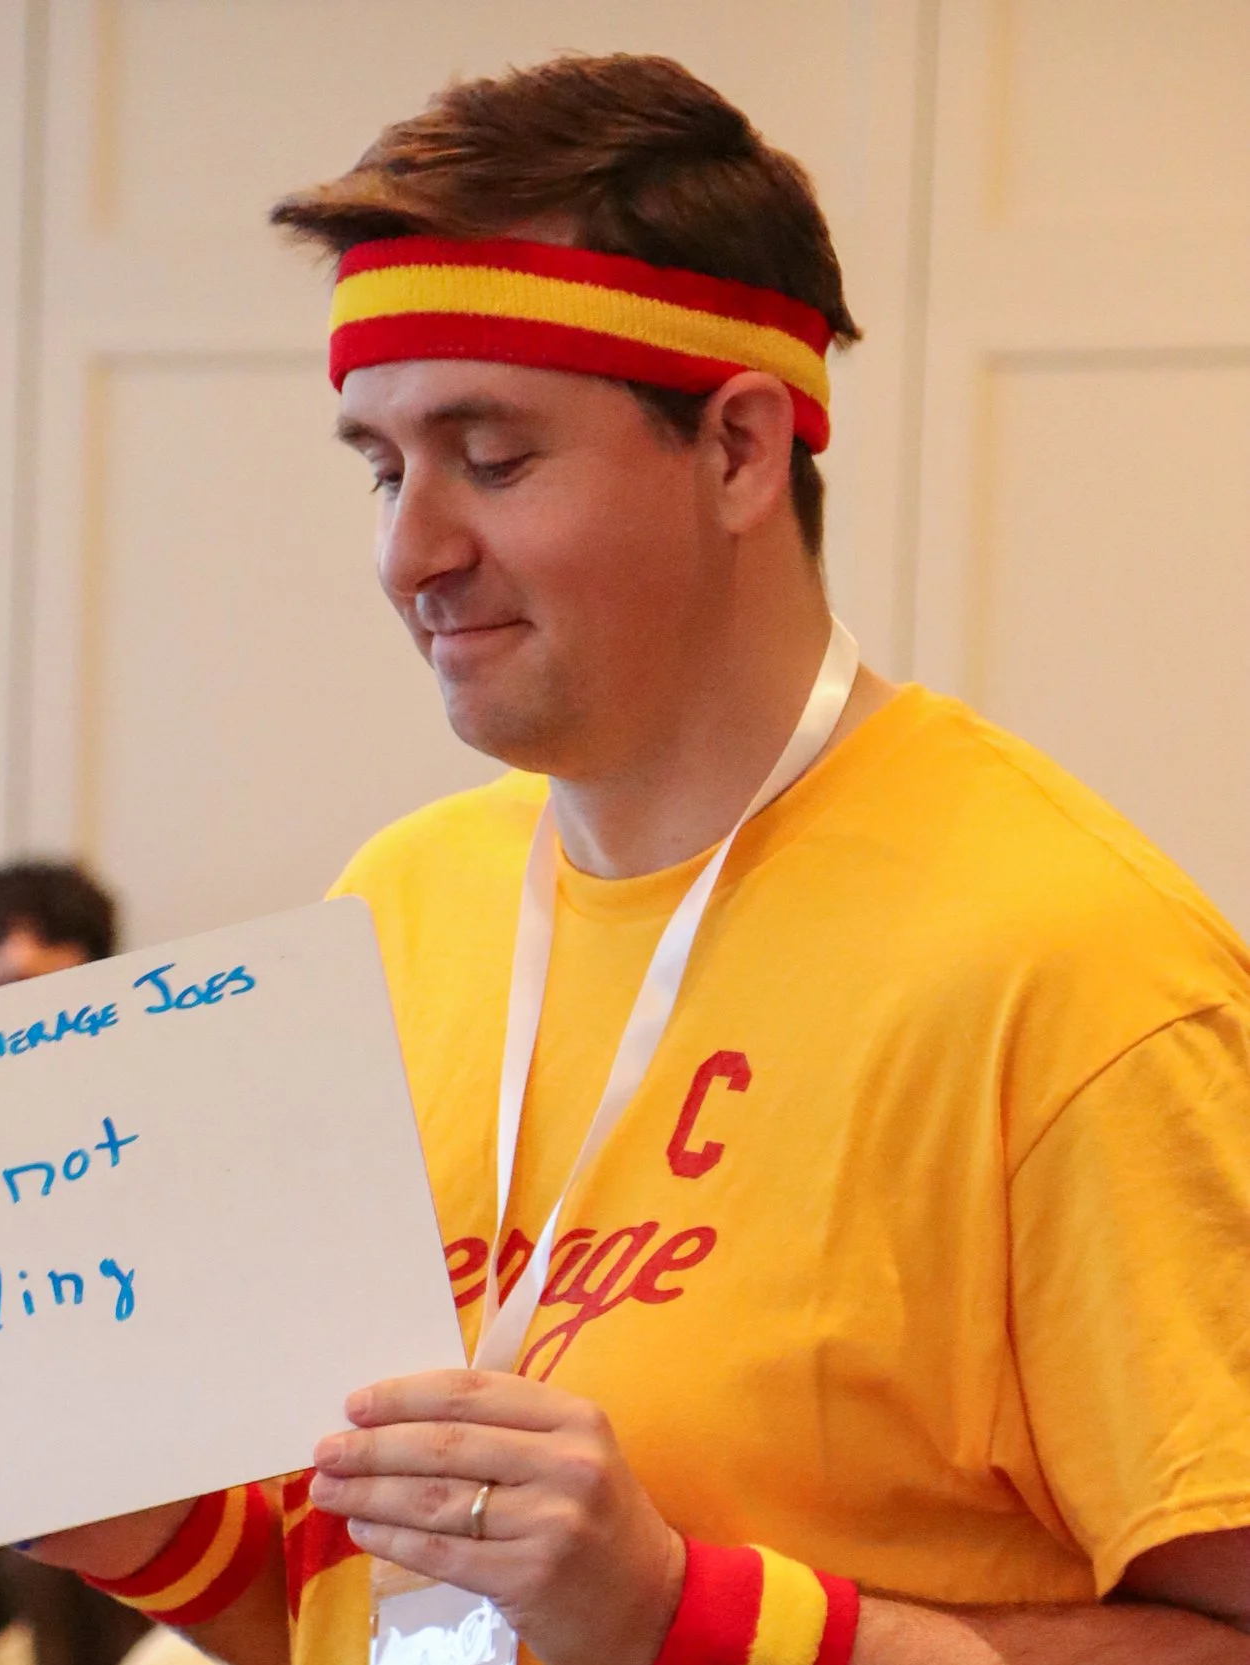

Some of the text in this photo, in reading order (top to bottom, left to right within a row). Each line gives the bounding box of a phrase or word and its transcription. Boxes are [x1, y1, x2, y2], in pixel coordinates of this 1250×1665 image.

[132, 962, 257, 1015] JOES
[1, 1116, 139, 1204] not
[666, 1050, 753, 1179] C
[444, 1220, 718, 1382] erage
